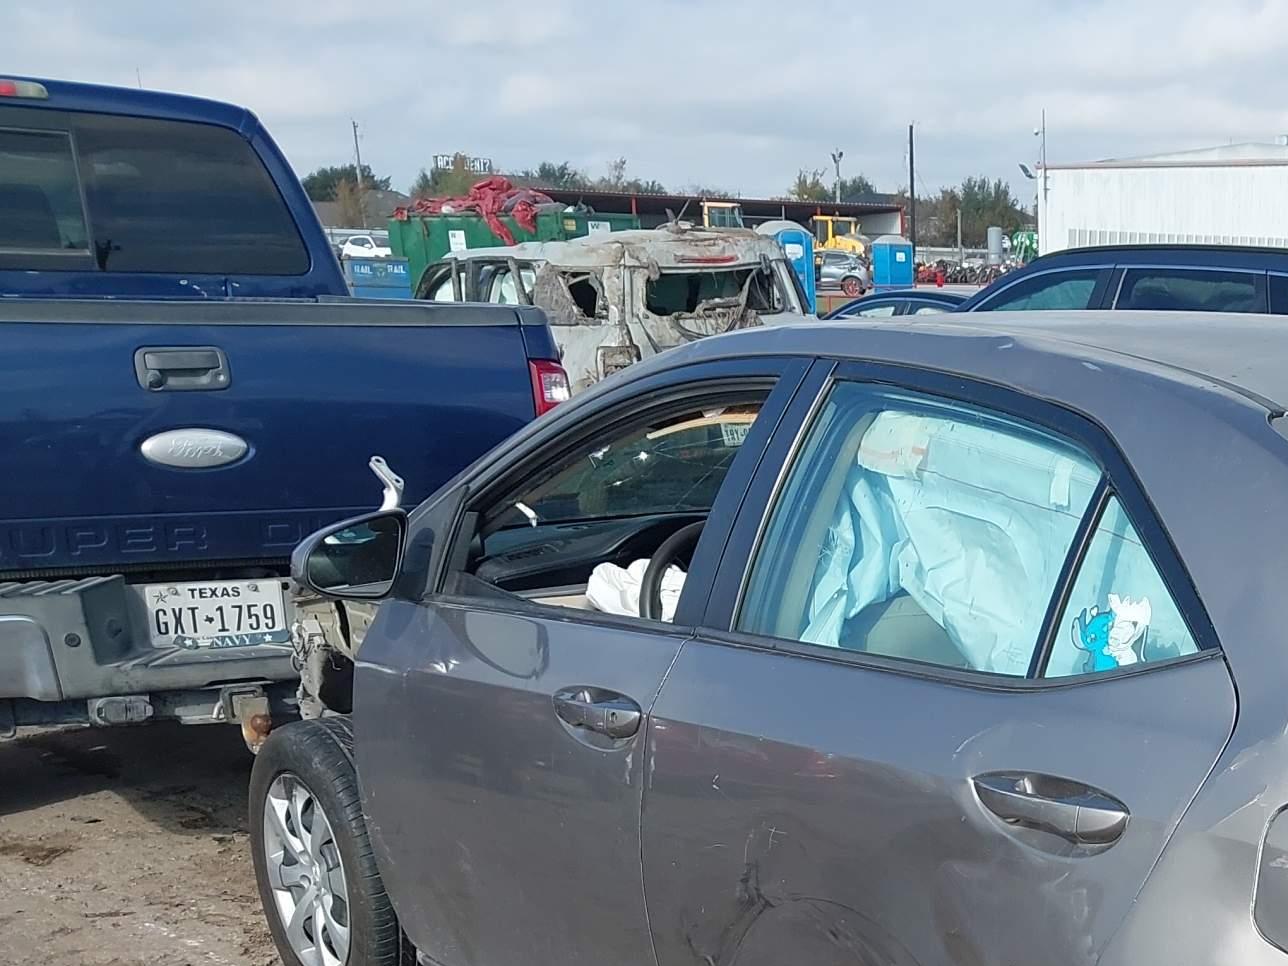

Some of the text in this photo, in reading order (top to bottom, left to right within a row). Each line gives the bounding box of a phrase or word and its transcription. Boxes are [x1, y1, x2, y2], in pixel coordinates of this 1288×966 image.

[437, 155, 491, 172] ACCDENT?
[168, 439, 224, 458] Ford
[0, 524, 208, 559] UPER
[187, 586, 241, 600] TEXAS
[155, 603, 277, 636] GXT 1759
[212, 634, 252, 649] NAVY
